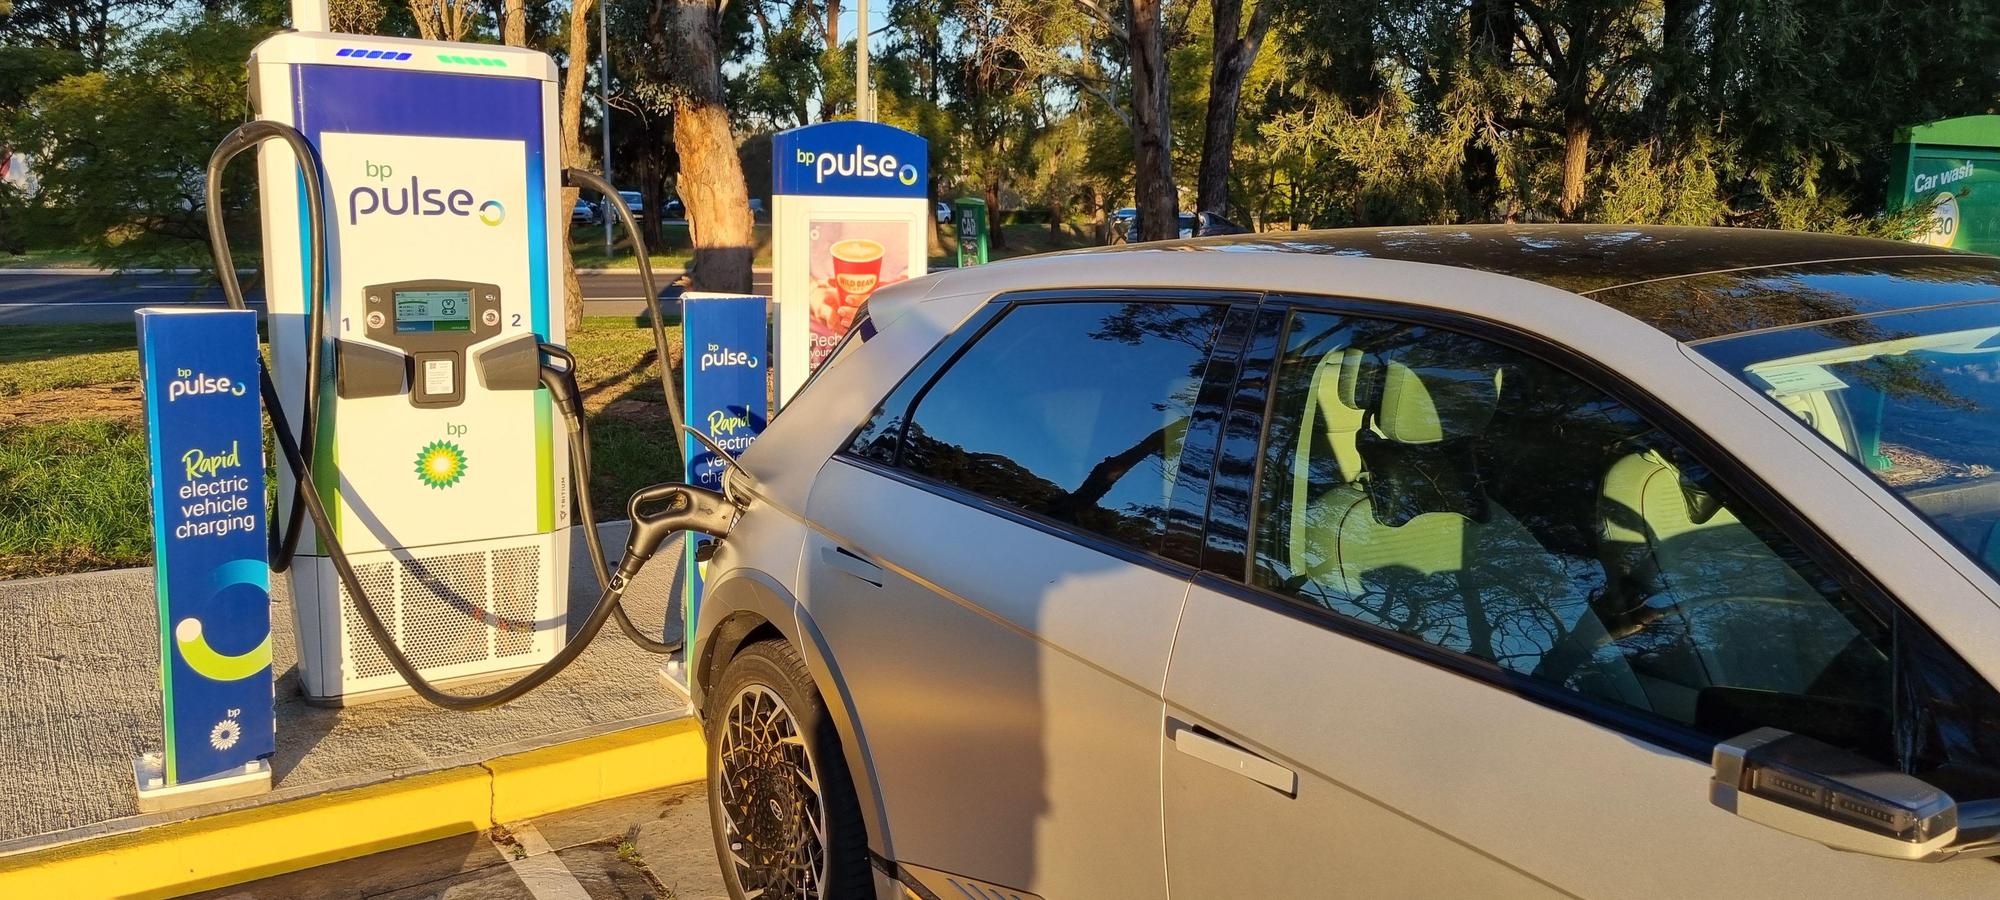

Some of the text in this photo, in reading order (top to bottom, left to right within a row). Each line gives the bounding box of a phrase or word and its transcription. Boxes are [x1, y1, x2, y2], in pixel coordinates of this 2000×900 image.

[365, 159, 393, 182] bp
[797, 144, 897, 184] bp pulse
[1915, 160, 1974, 193] Car wash
[349, 175, 474, 226] pulse
[342, 317, 350, 331] 1
[511, 313, 521, 327] 2
[701, 348, 748, 371] pulse
[708, 343, 719, 352] bp
[177, 367, 192, 378] bp
[169, 372, 231, 402] pulse
[447, 421, 468, 438] bp
[707, 404, 751, 438] Rapid
[181, 440, 241, 482] Rapid
[179, 475, 248, 499] electric
[182, 494, 248, 518] vehicle
[175, 514, 255, 539] charging
[227, 708, 241, 718] bp
